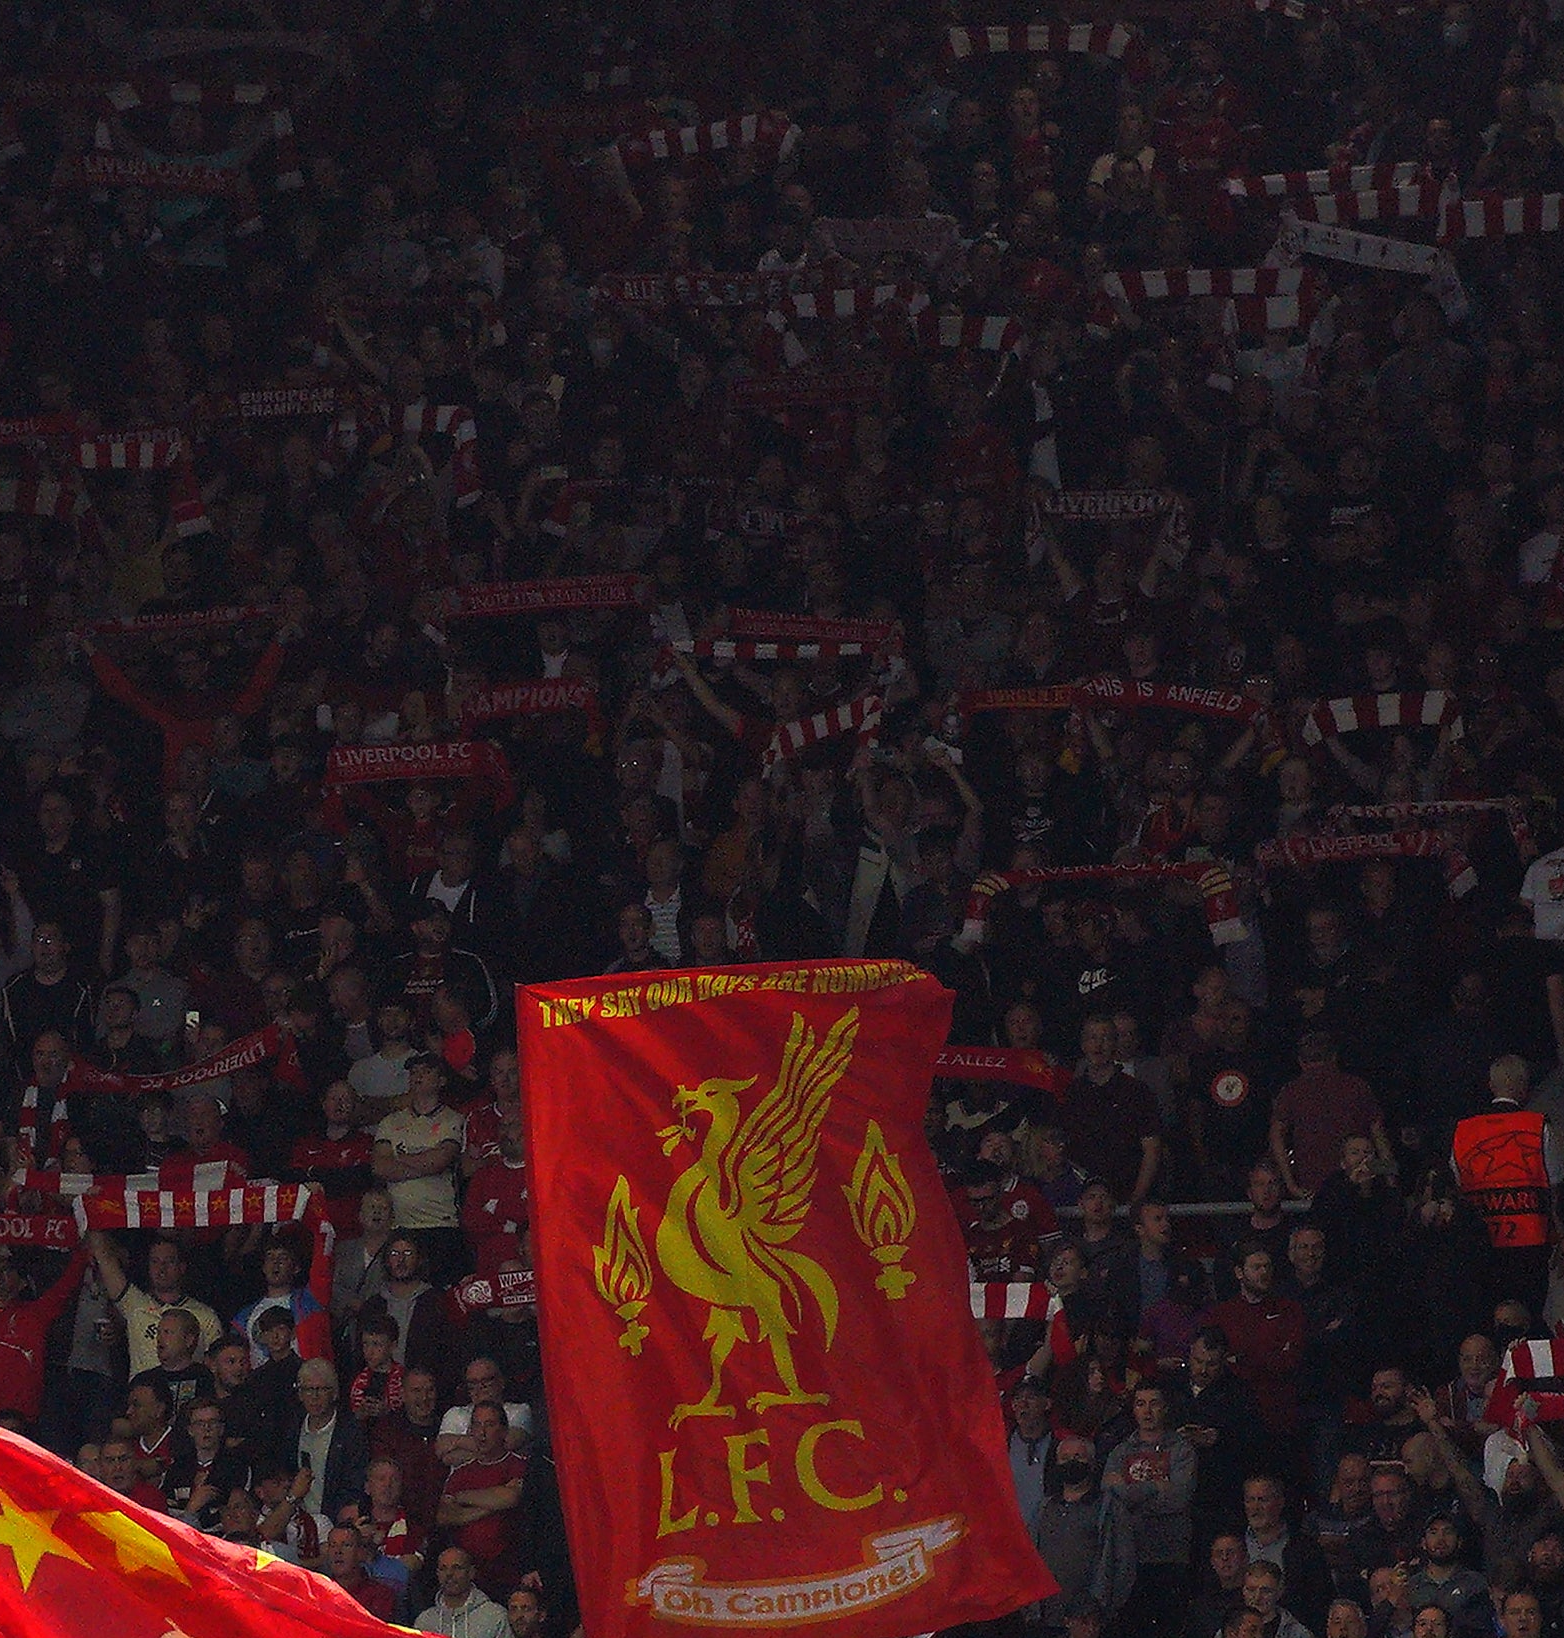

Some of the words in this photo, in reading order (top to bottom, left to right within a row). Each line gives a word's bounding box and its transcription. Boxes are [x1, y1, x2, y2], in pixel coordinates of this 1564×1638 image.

[1085, 678, 1125, 699] THIS
[1136, 679, 1154, 697] IS
[1166, 682, 1243, 712] ANFIELD
[335, 745, 442, 767] LIVERPOOL
[448, 742, 472, 760] FC
[538, 997, 595, 1029] THEY
[601, 992, 642, 1019] SAY
[646, 979, 693, 1012] OUR
[697, 970, 755, 1001] DAYS
[761, 969, 811, 993] ARE
[952, 1053, 1008, 1070] ALLEZ
[44, 1217, 68, 1240] FC
[654, 1419, 909, 1540] L.F.C.
[662, 1585, 715, 1616] Oh
[727, 1557, 923, 1618] Campione!
